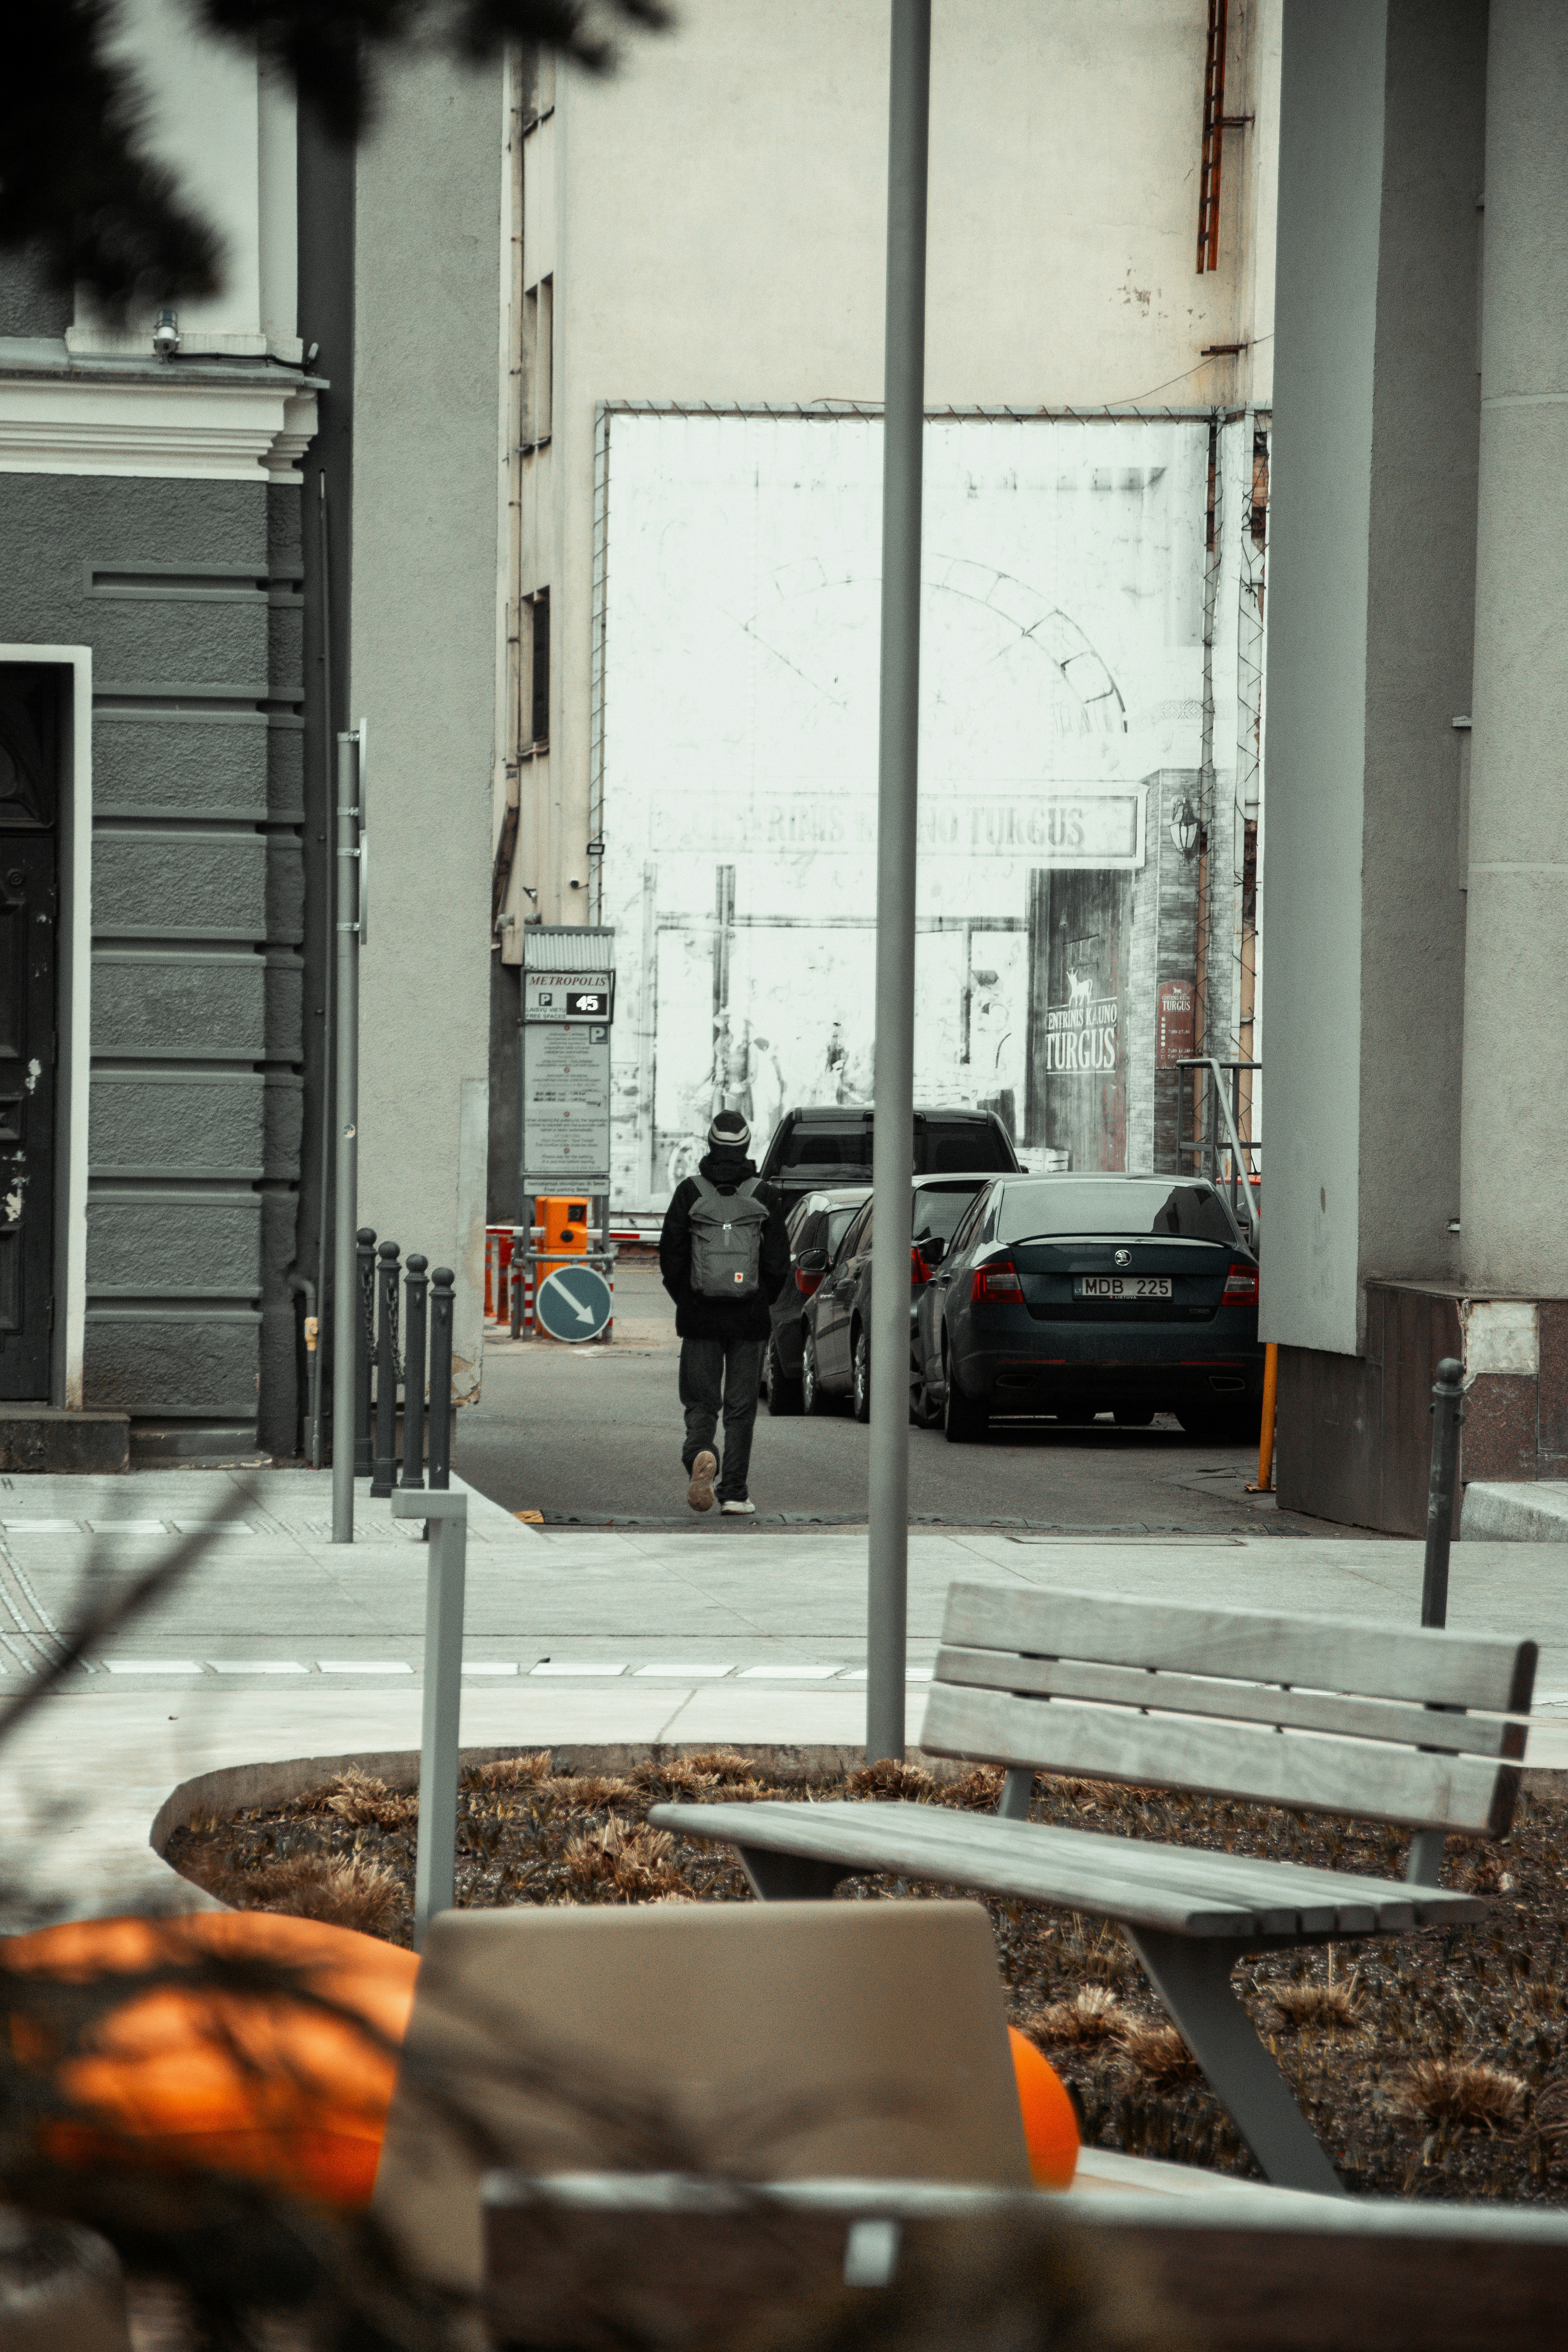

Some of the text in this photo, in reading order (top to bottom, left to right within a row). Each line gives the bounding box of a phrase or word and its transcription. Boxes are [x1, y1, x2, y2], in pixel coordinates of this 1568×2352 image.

[529, 976, 608, 986] METROPOLIS
[576, 995, 599, 1011] 45
[1162, 1001, 1191, 1011] TURGUS
[1085, 1004, 1117, 1025] KAUNO
[1045, 1027, 1116, 1070] TURGUS
[1085, 1279, 1169, 1295] MDB 225
